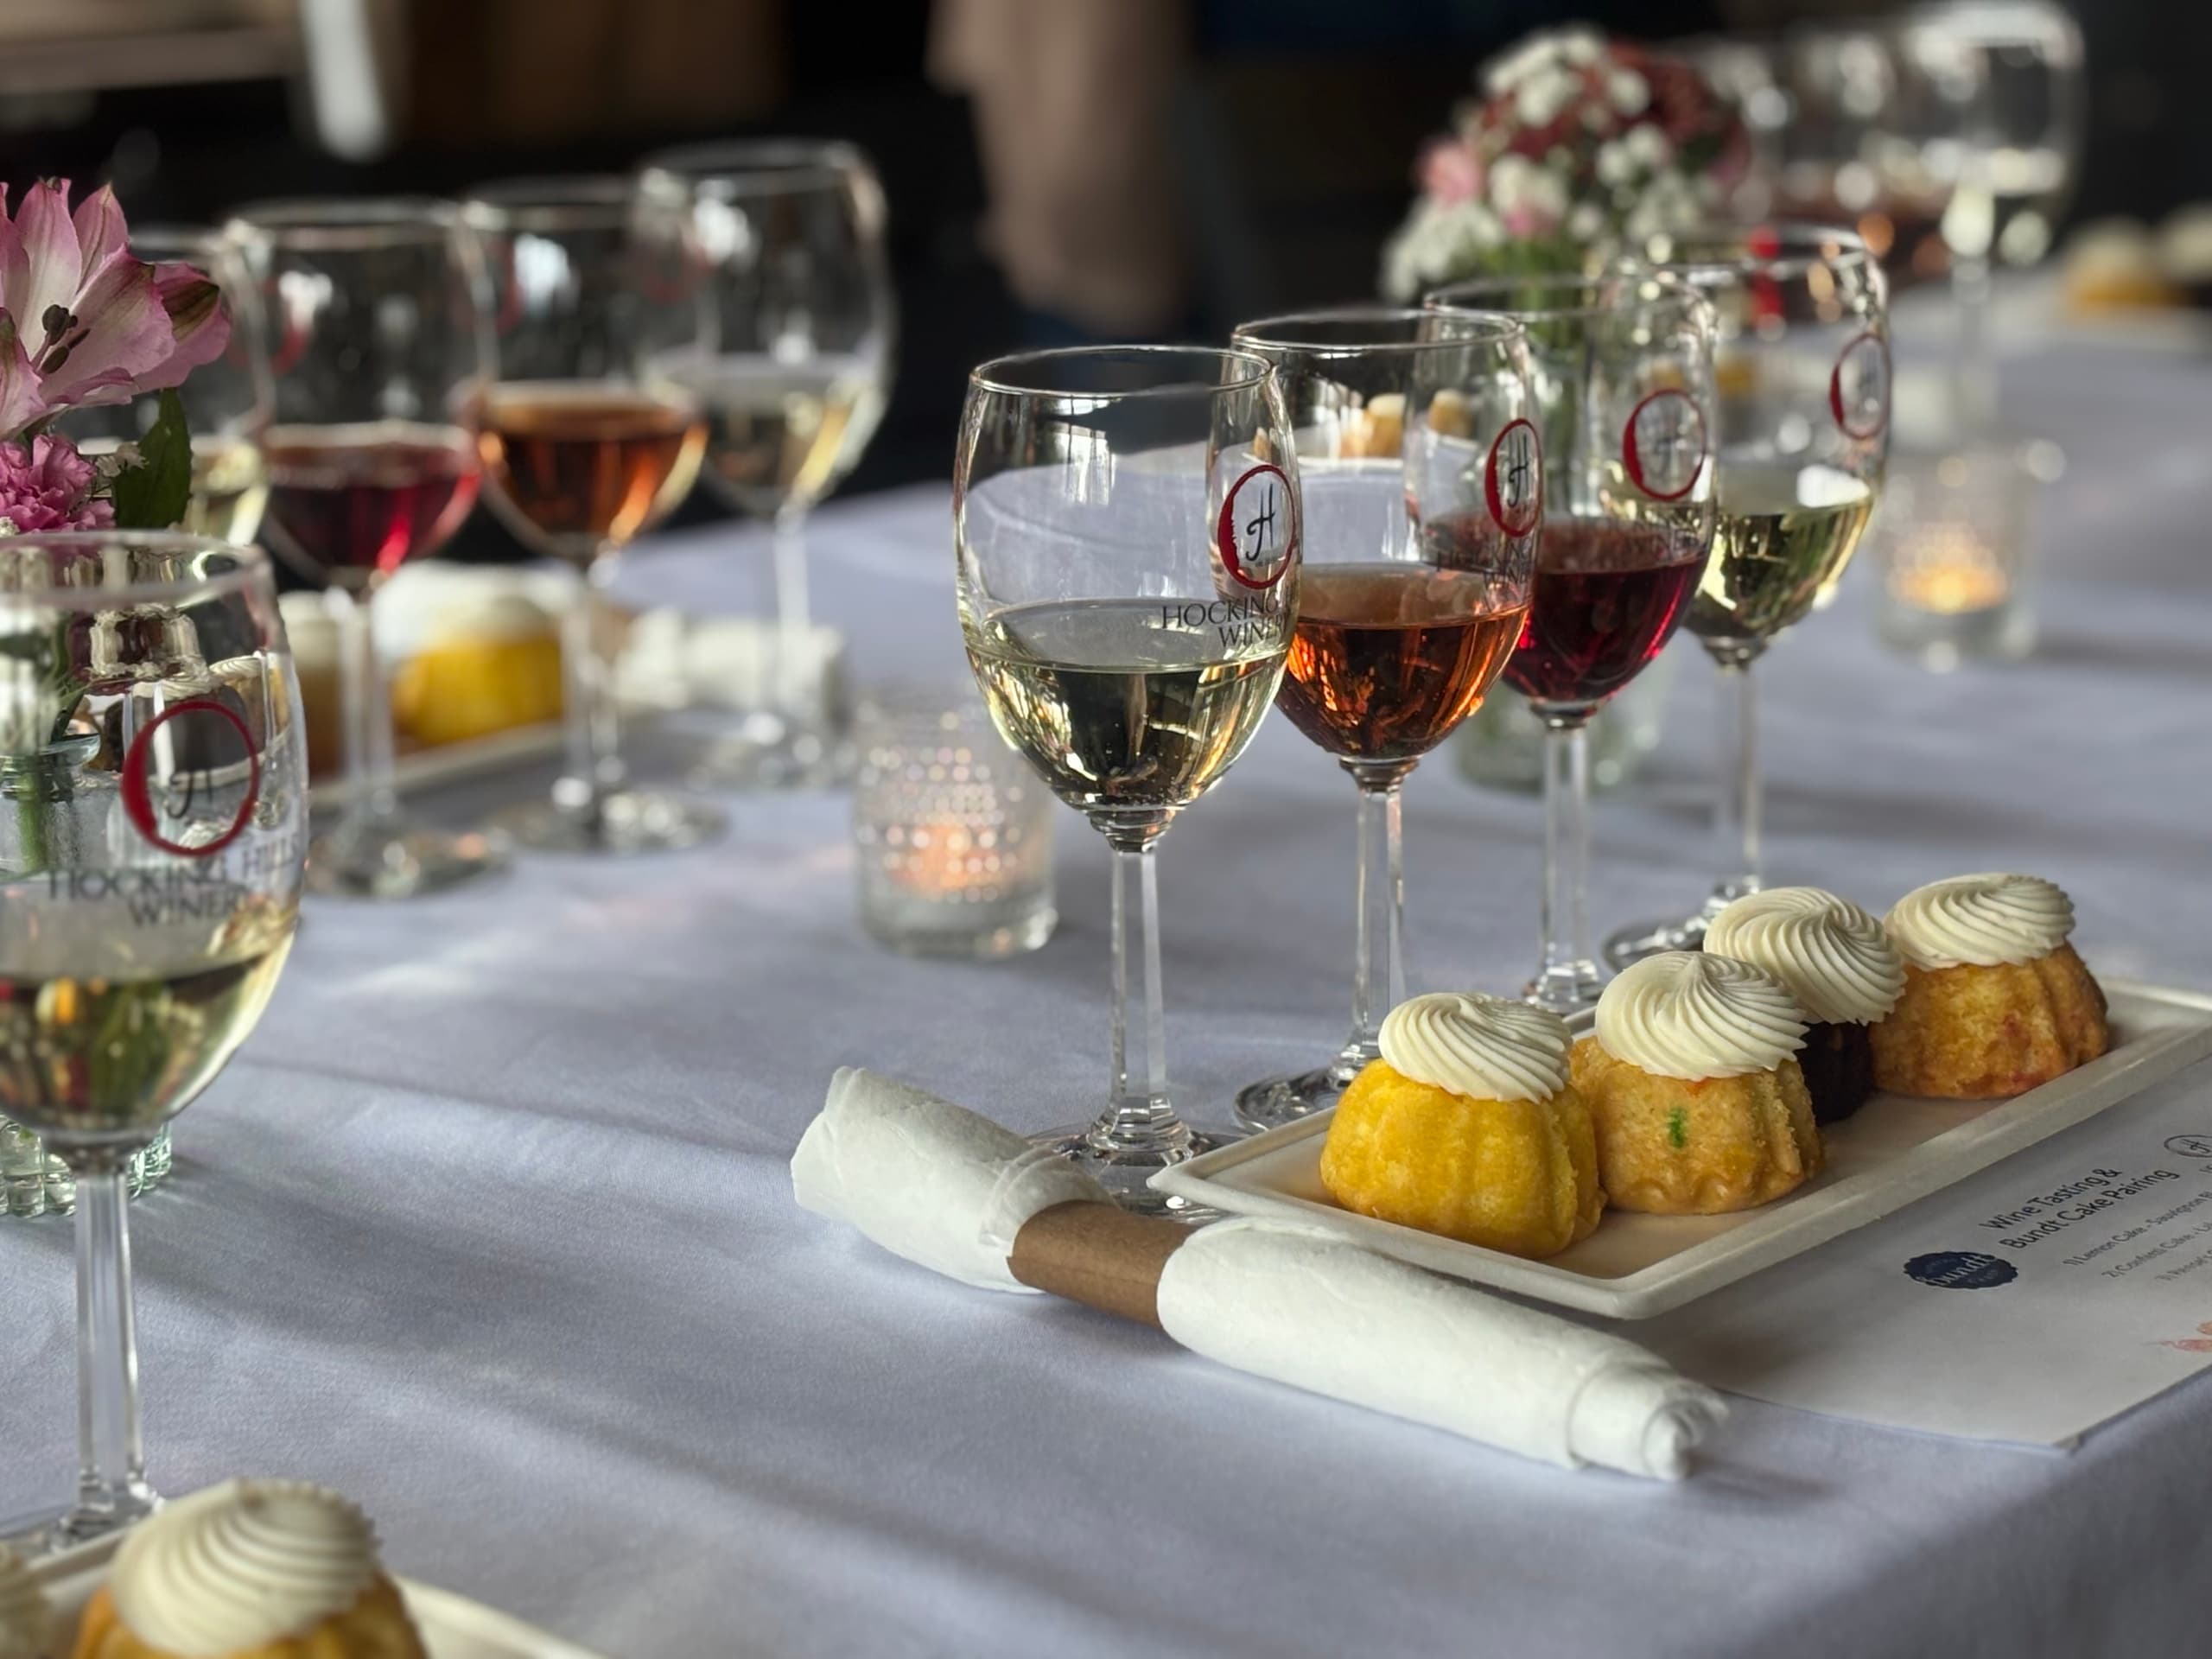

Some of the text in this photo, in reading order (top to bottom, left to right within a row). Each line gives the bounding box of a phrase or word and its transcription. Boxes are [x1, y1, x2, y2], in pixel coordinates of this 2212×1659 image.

[1245, 481, 1276, 562] H
[1979, 1168, 2123, 1230] Wine Tasting &
[1999, 1169, 2181, 1249] Bundt Cake Pairing
